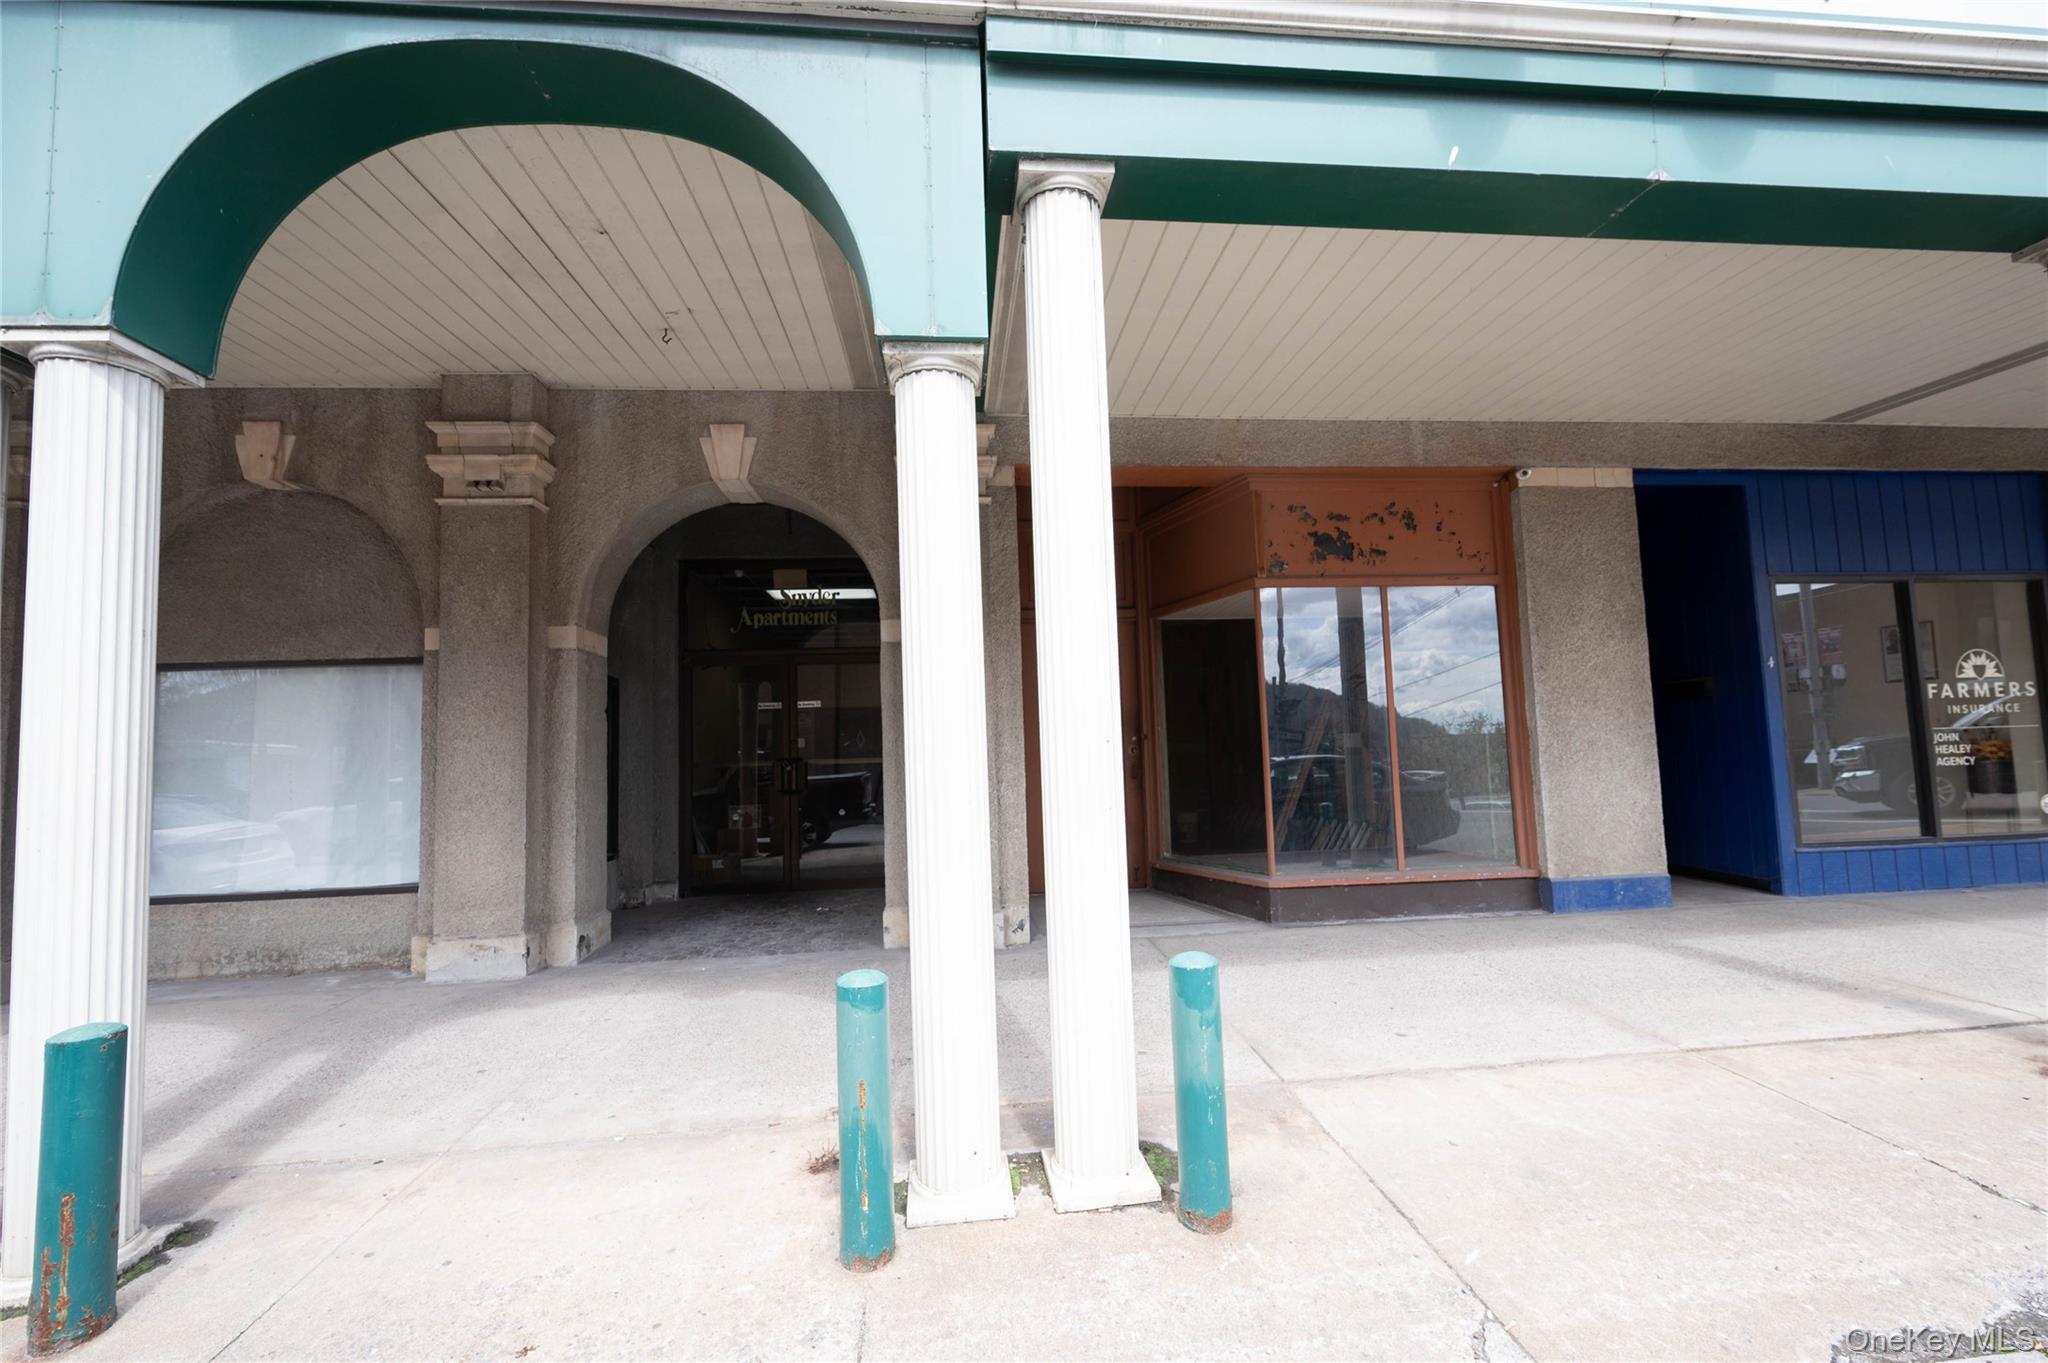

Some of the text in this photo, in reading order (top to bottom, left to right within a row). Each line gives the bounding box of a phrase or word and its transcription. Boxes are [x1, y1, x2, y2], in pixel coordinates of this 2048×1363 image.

[779, 586, 841, 608] Snyder
[730, 607, 838, 633] Apartments
[1927, 681, 2037, 699] FARMERS
[1933, 732, 1960, 744] JOHN
[1935, 744, 1972, 754] HEALEY
[1936, 756, 1976, 766] AGENCY
